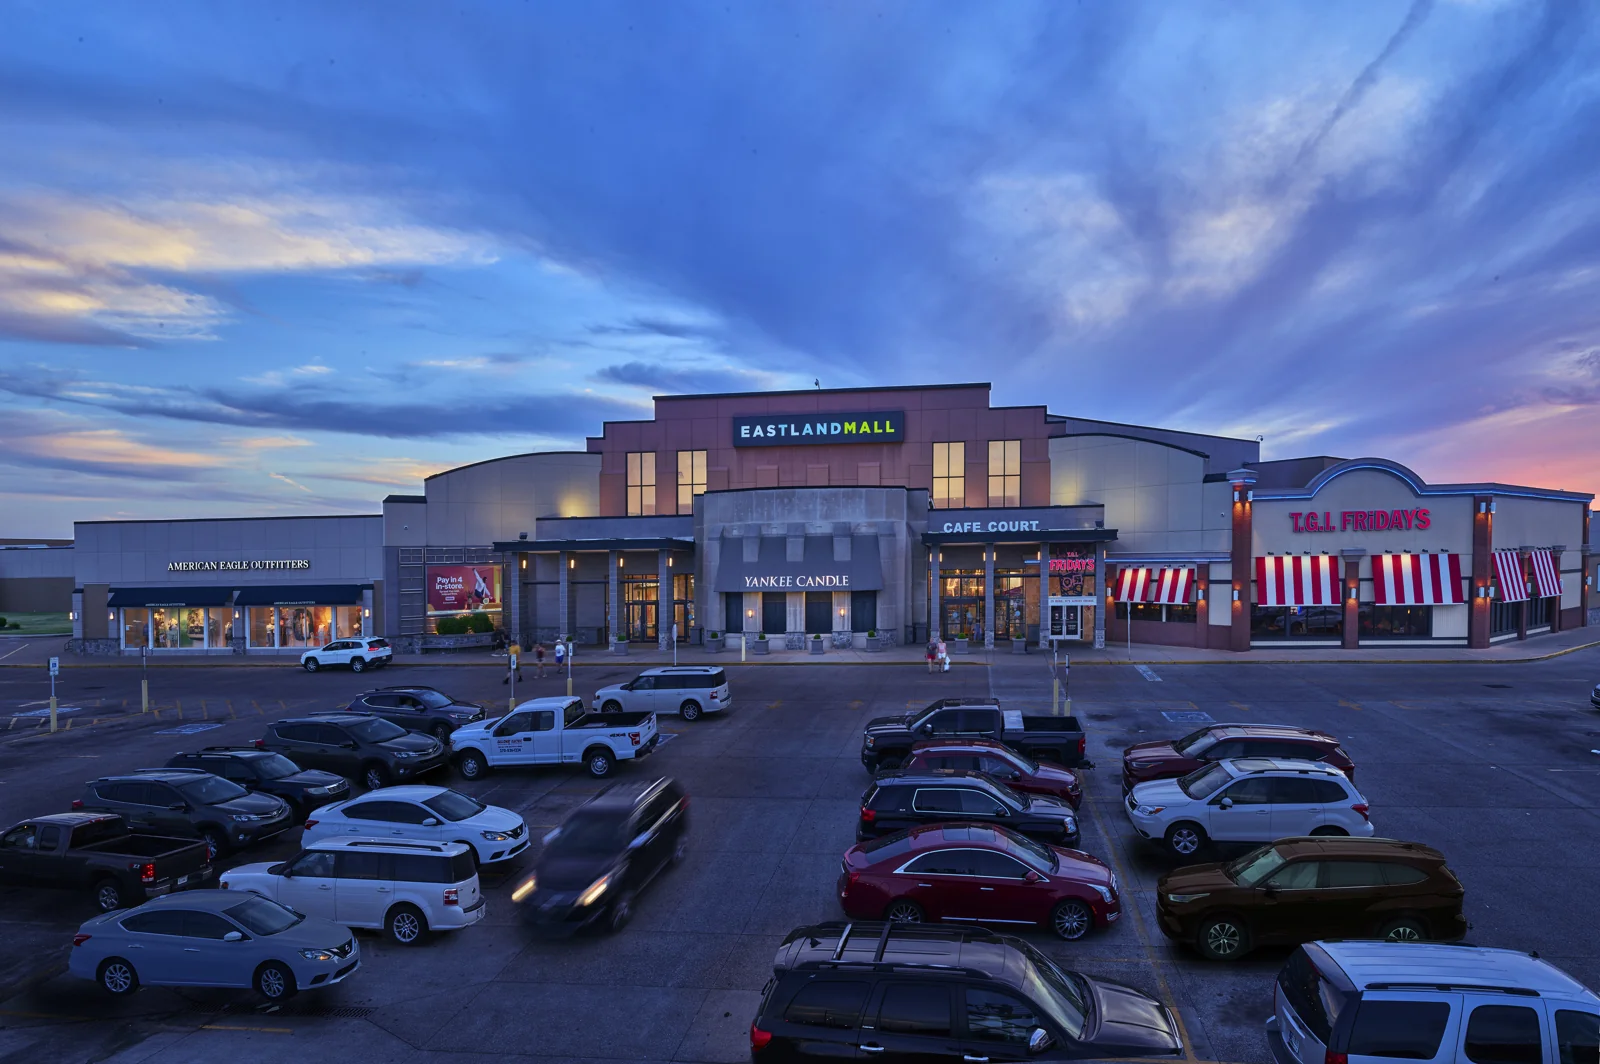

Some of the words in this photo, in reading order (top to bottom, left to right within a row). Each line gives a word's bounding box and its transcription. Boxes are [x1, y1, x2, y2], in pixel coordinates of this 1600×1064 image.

[943, 522, 981, 533] CAFE
[987, 520, 1039, 532] COURT
[1289, 511, 1336, 532] T.G.I.
[167, 561, 217, 571] AMERICAN
[219, 560, 249, 570] EAGLE
[250, 559, 309, 570] OUTFITTERS
[436, 576, 450, 584] Pay
[744, 576, 793, 587] YANKEE
[796, 575, 849, 587] CANDLE
